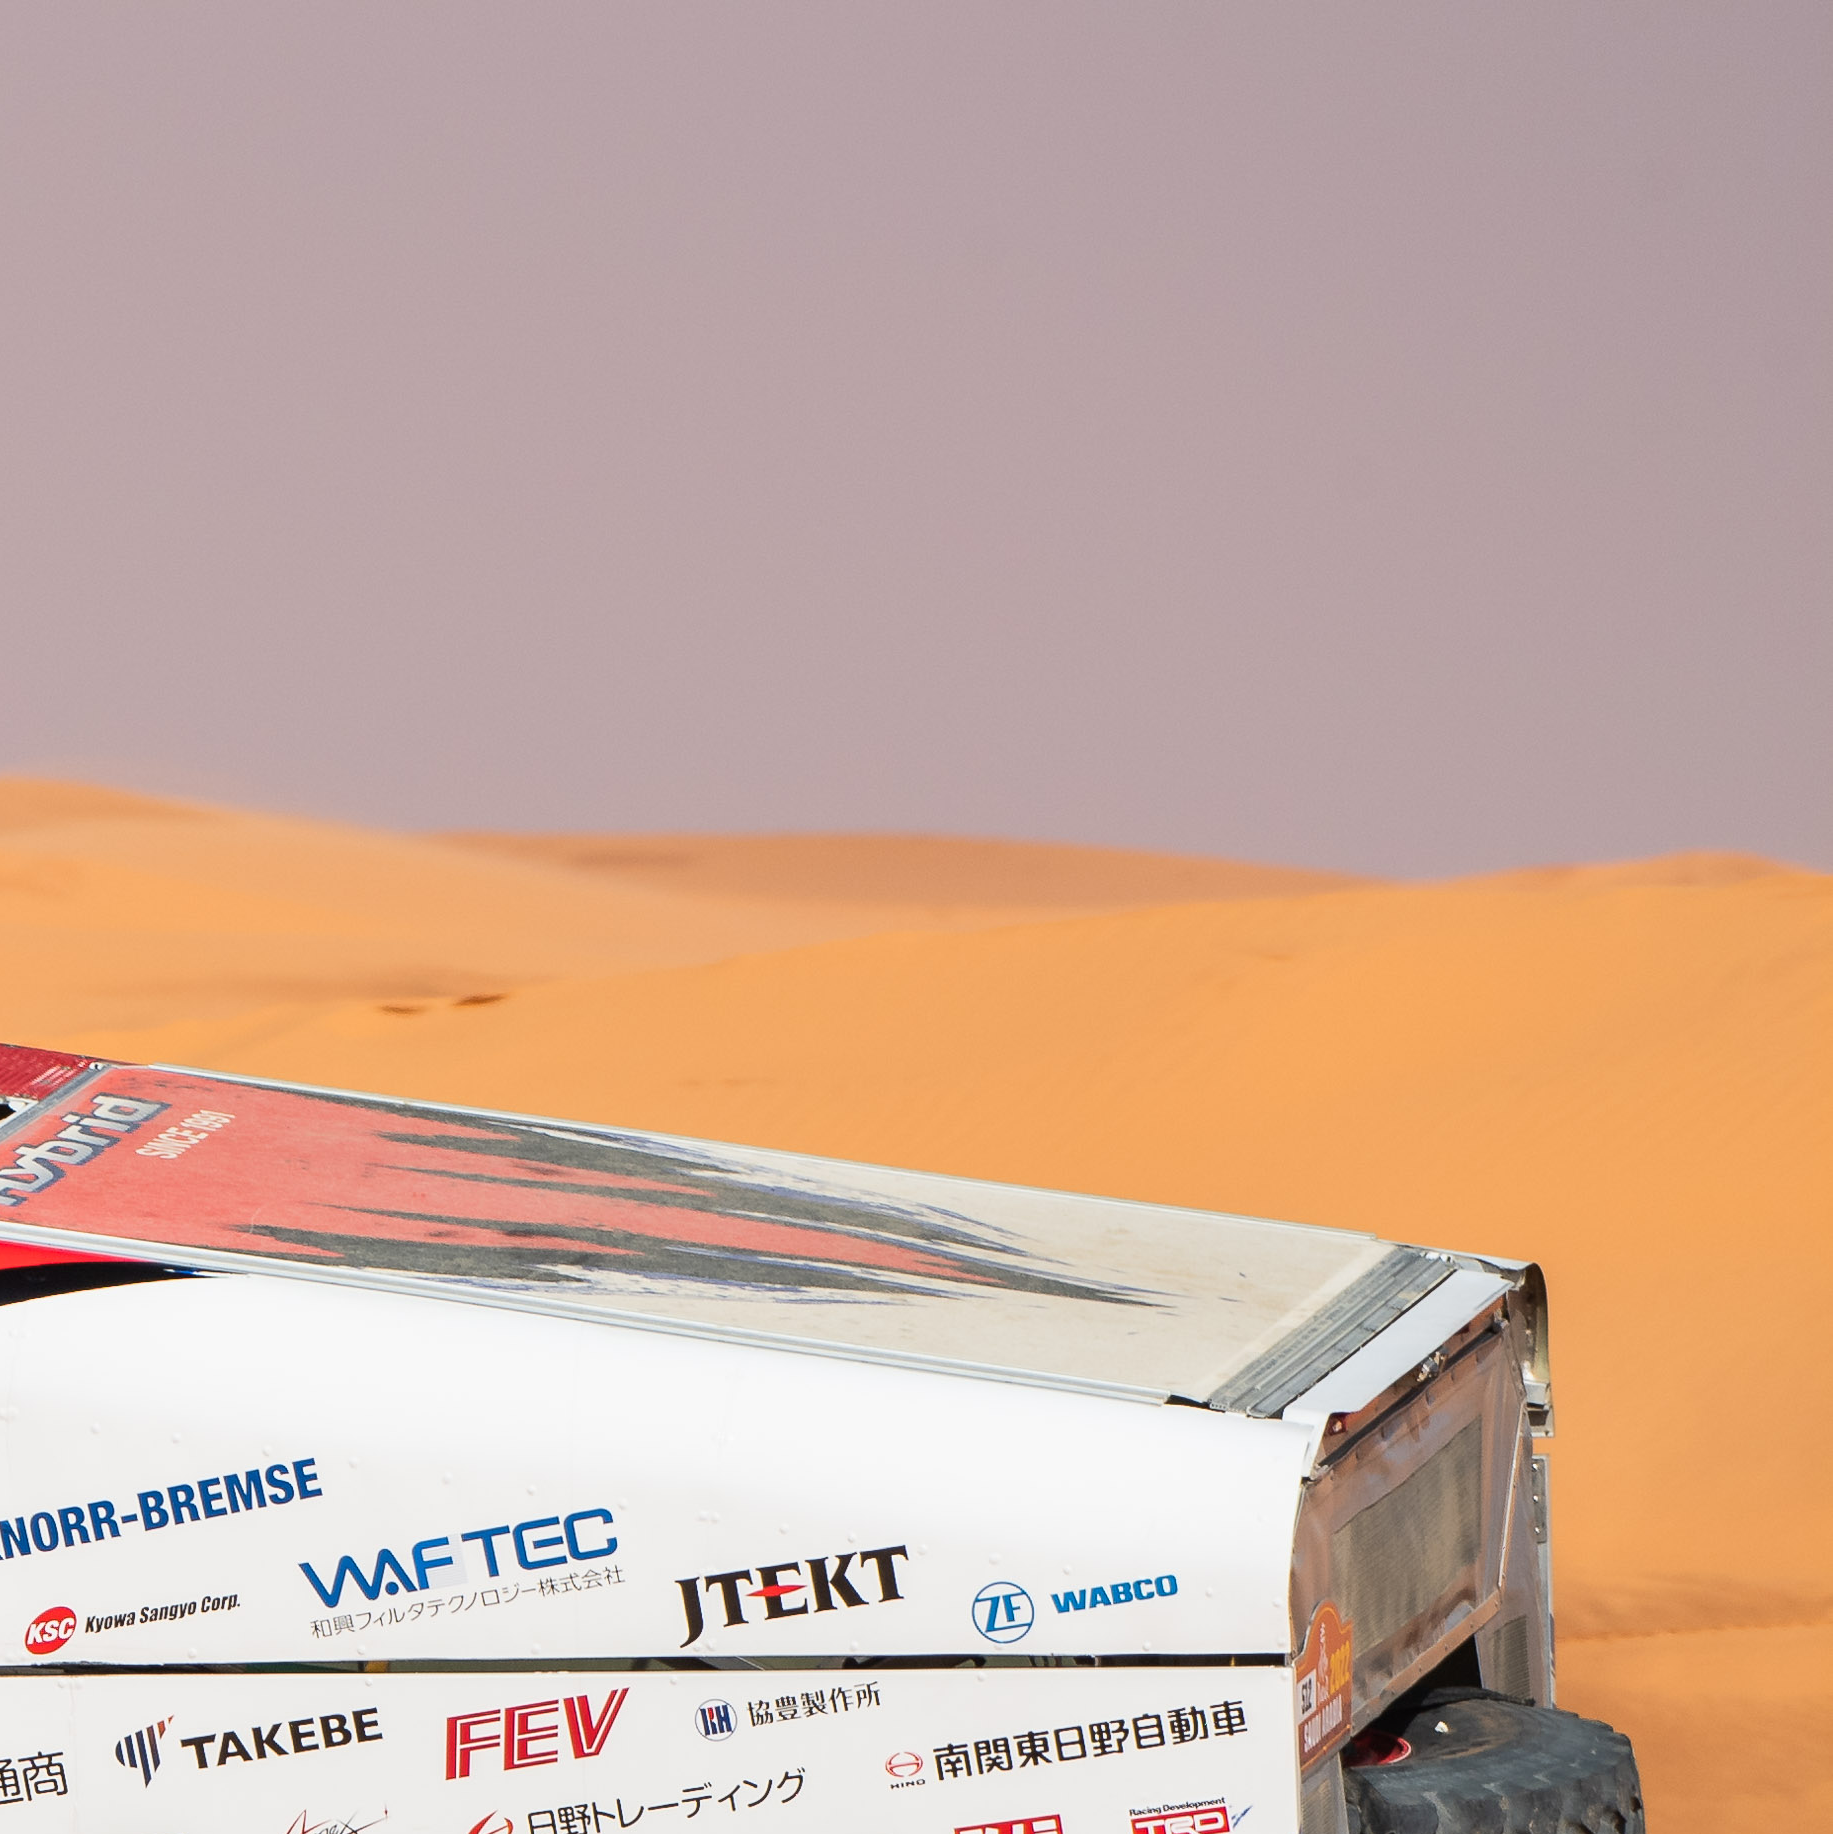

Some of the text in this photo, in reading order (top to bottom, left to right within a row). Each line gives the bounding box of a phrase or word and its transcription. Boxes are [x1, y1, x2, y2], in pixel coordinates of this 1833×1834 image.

[85, 1594, 242, 1636] Kyowa Sangyo Corp.
[309, 1564, 627, 1640] 和興フィルタテクノロジー株式会社
[674, 1544, 910, 1649] JTEKT
[1050, 1574, 1179, 1614] WABCO
[27, 1616, 75, 1646] KSC
[747, 1681, 882, 1728] 協豊製作所
[179, 1706, 384, 1770] TAKEBE
[444, 1686, 631, 1782] FEV
[933, 1699, 1249, 1783] 南関東日野自動車
[890, 1778, 927, 1790] HINO
[1128, 1797, 1226, 1818] Racing Development
